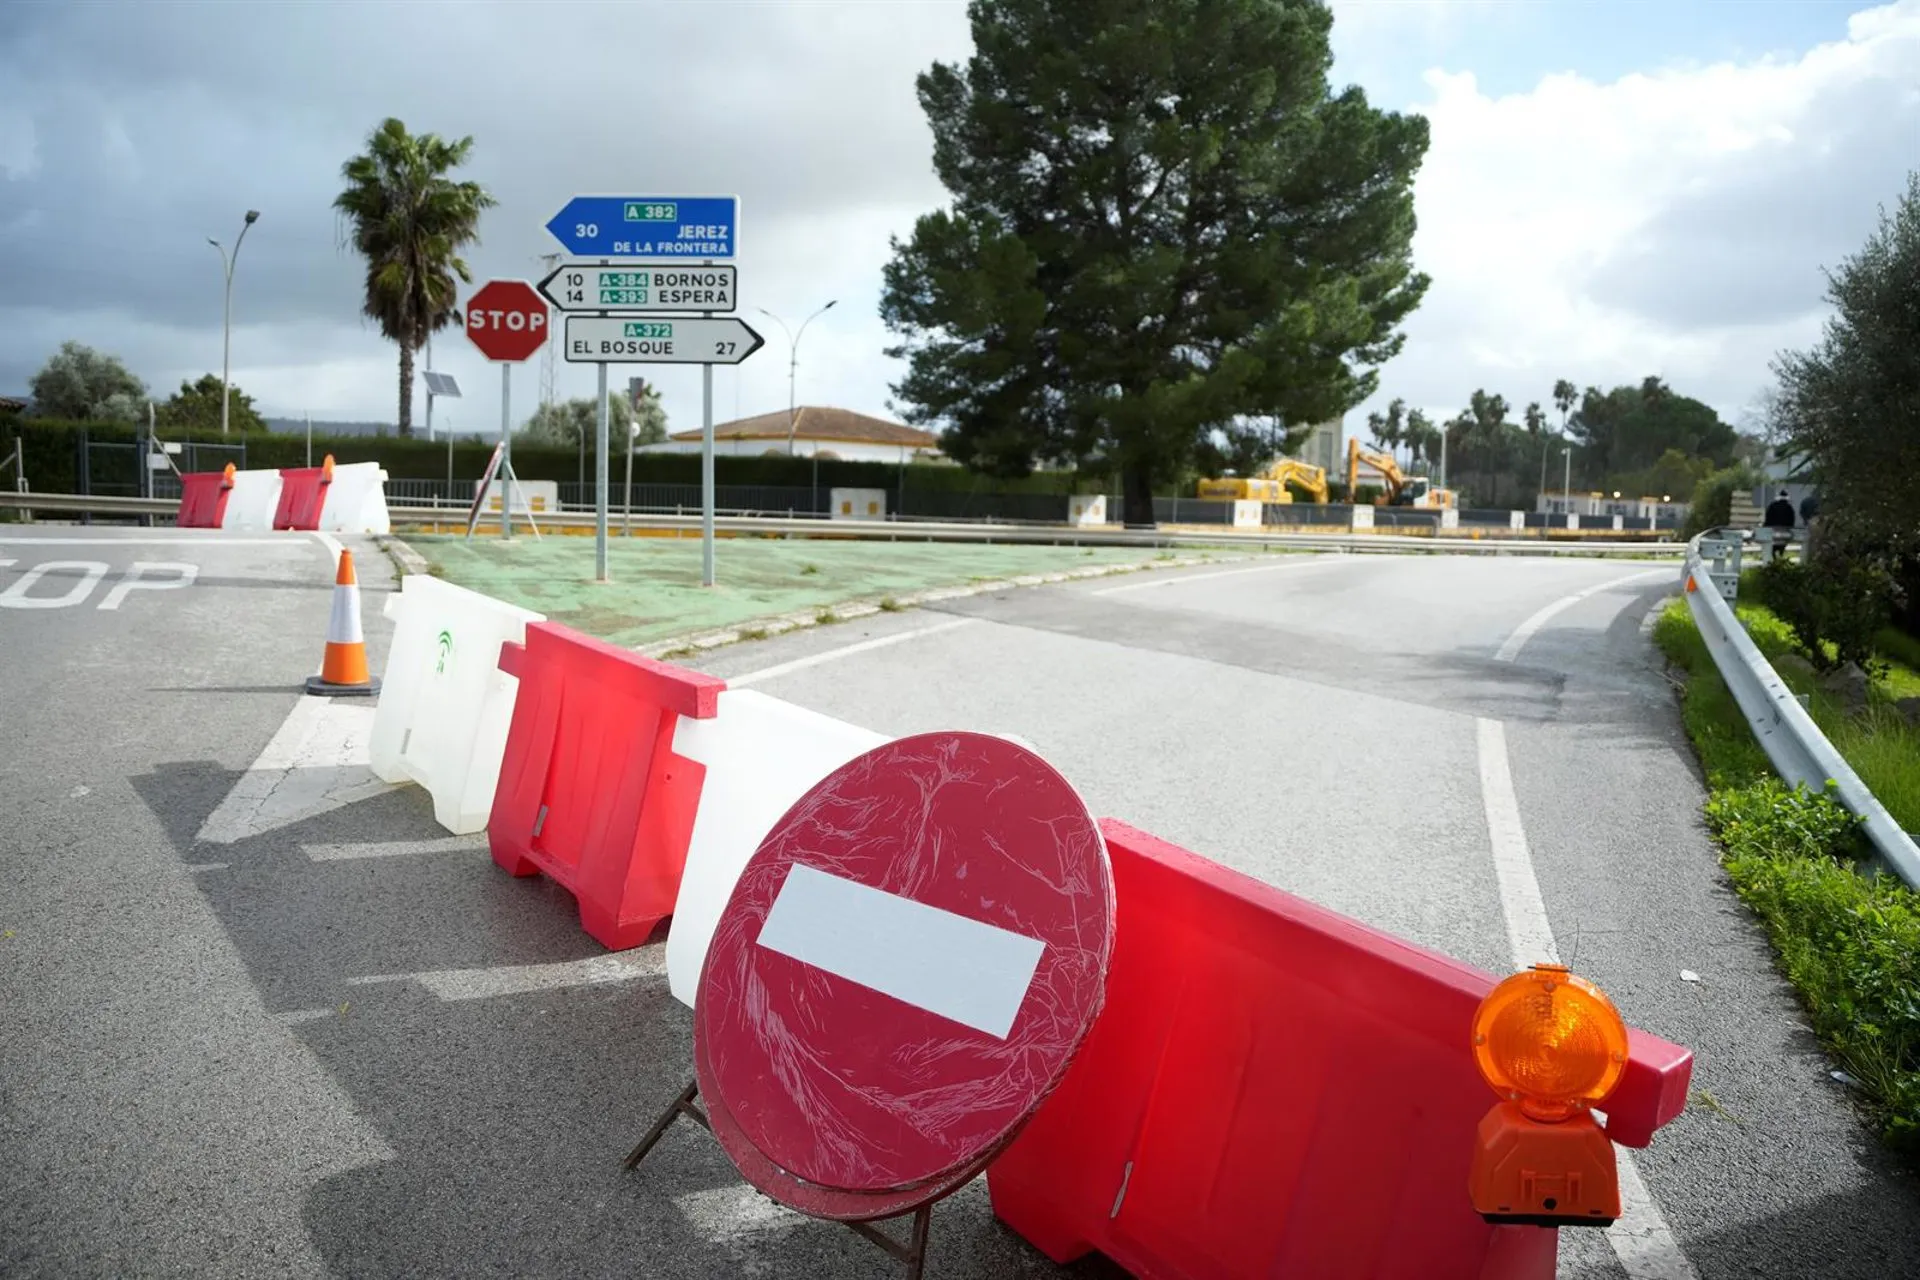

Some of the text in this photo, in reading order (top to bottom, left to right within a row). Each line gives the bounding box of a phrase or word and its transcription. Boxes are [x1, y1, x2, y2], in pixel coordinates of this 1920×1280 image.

[627, 206, 674, 218] A 382
[575, 224, 728, 239] 30 JEREZ
[614, 242, 728, 253] DE LA FRONTERA
[566, 274, 728, 287] 10 A-384 BORNOS
[566, 290, 728, 303] 14 A-393 ESPERA
[469, 309, 545, 332] STOP
[626, 324, 671, 337] A-372
[573, 341, 736, 355] EL BOSQUE 27
[0, 559, 199, 610] OP
